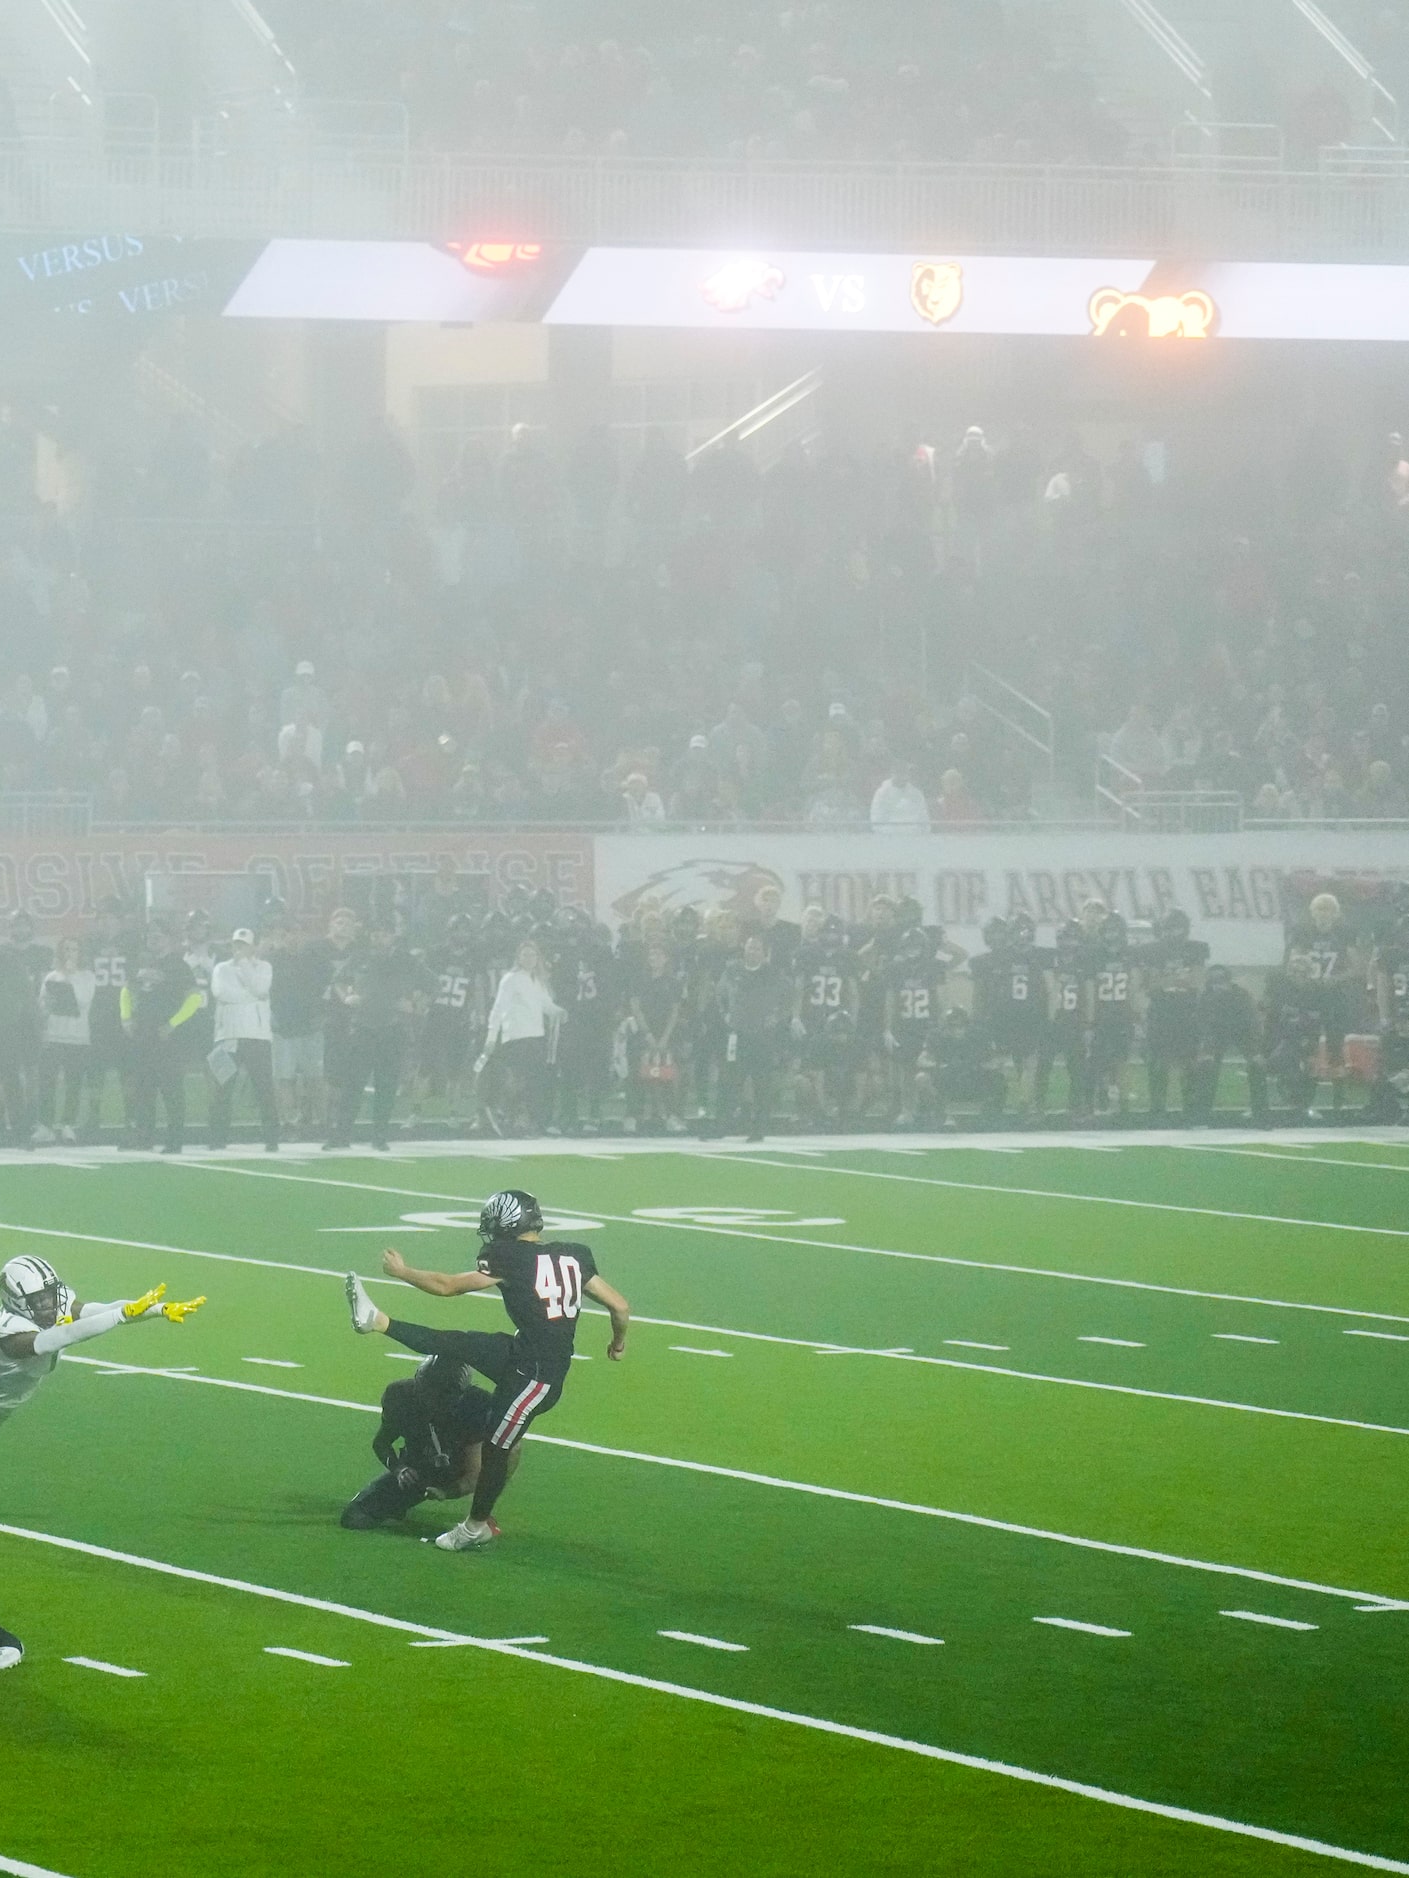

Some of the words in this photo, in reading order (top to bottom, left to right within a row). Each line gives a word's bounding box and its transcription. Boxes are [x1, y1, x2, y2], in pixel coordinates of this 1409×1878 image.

[16, 233, 144, 282] VERSUS
[810, 273, 865, 313] VS
[935, 867, 986, 924] OF
[436, 974, 470, 1008] 25
[810, 975, 843, 1007] 33
[1098, 972, 1129, 1001] 22
[535, 1254, 582, 1320] 40
